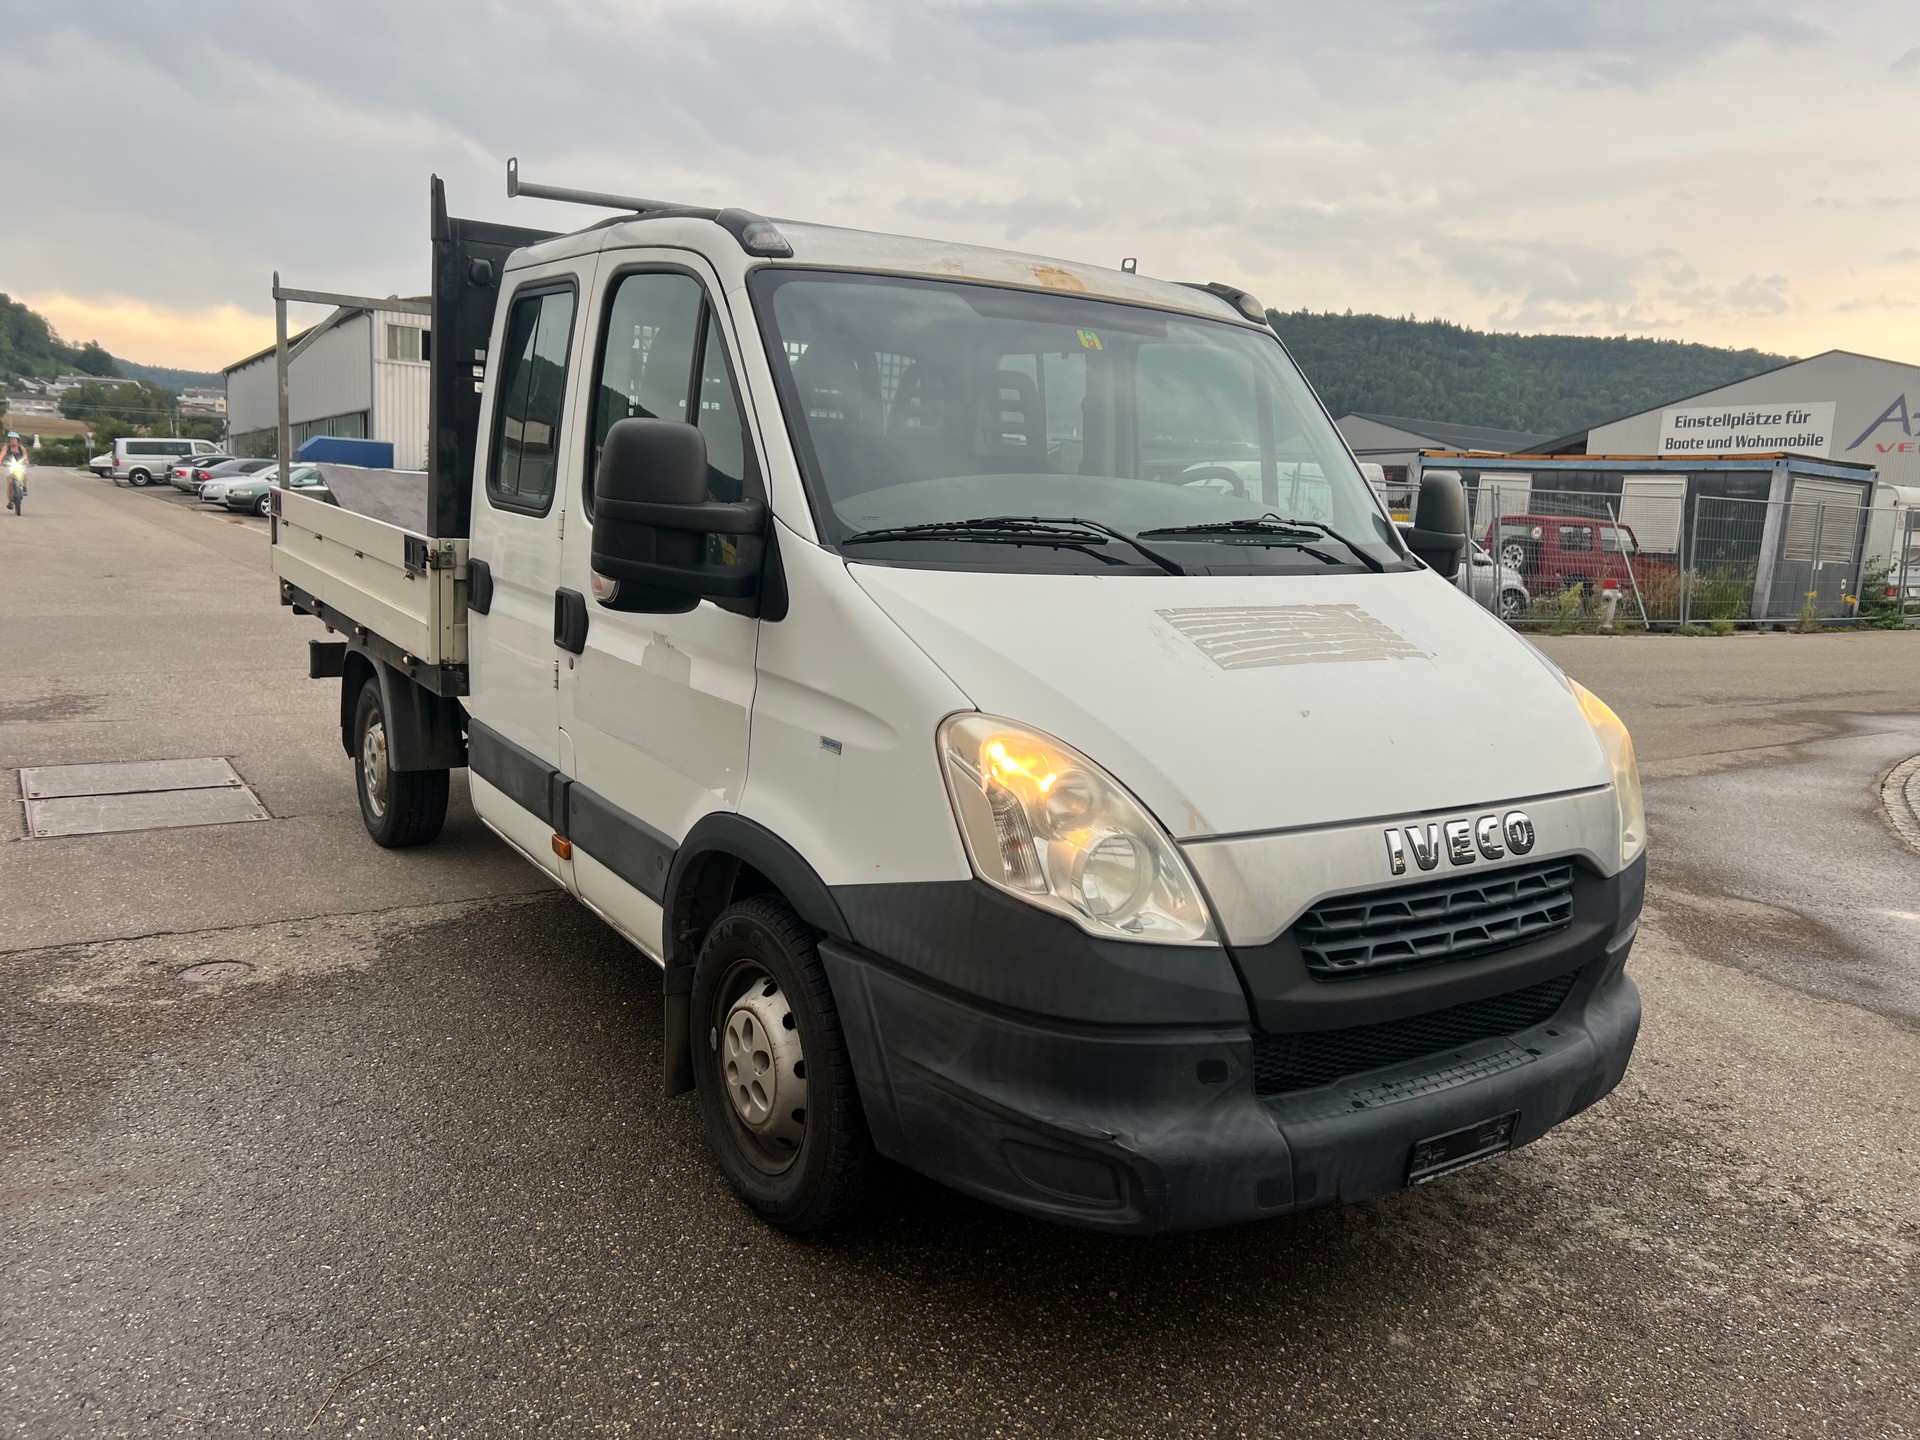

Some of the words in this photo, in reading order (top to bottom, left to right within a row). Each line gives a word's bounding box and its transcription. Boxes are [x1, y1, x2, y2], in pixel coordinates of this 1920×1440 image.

[1674, 412, 1782, 429] Einstellplätze
[1785, 410, 1811, 424] für
[1845, 393, 1920, 451] A
[1665, 437, 1704, 450] Boote
[1706, 435, 1732, 449] und
[1735, 433, 1824, 448] Wohnmobile
[1875, 442, 1920, 453] VE
[1384, 810, 1535, 875] IVECO
